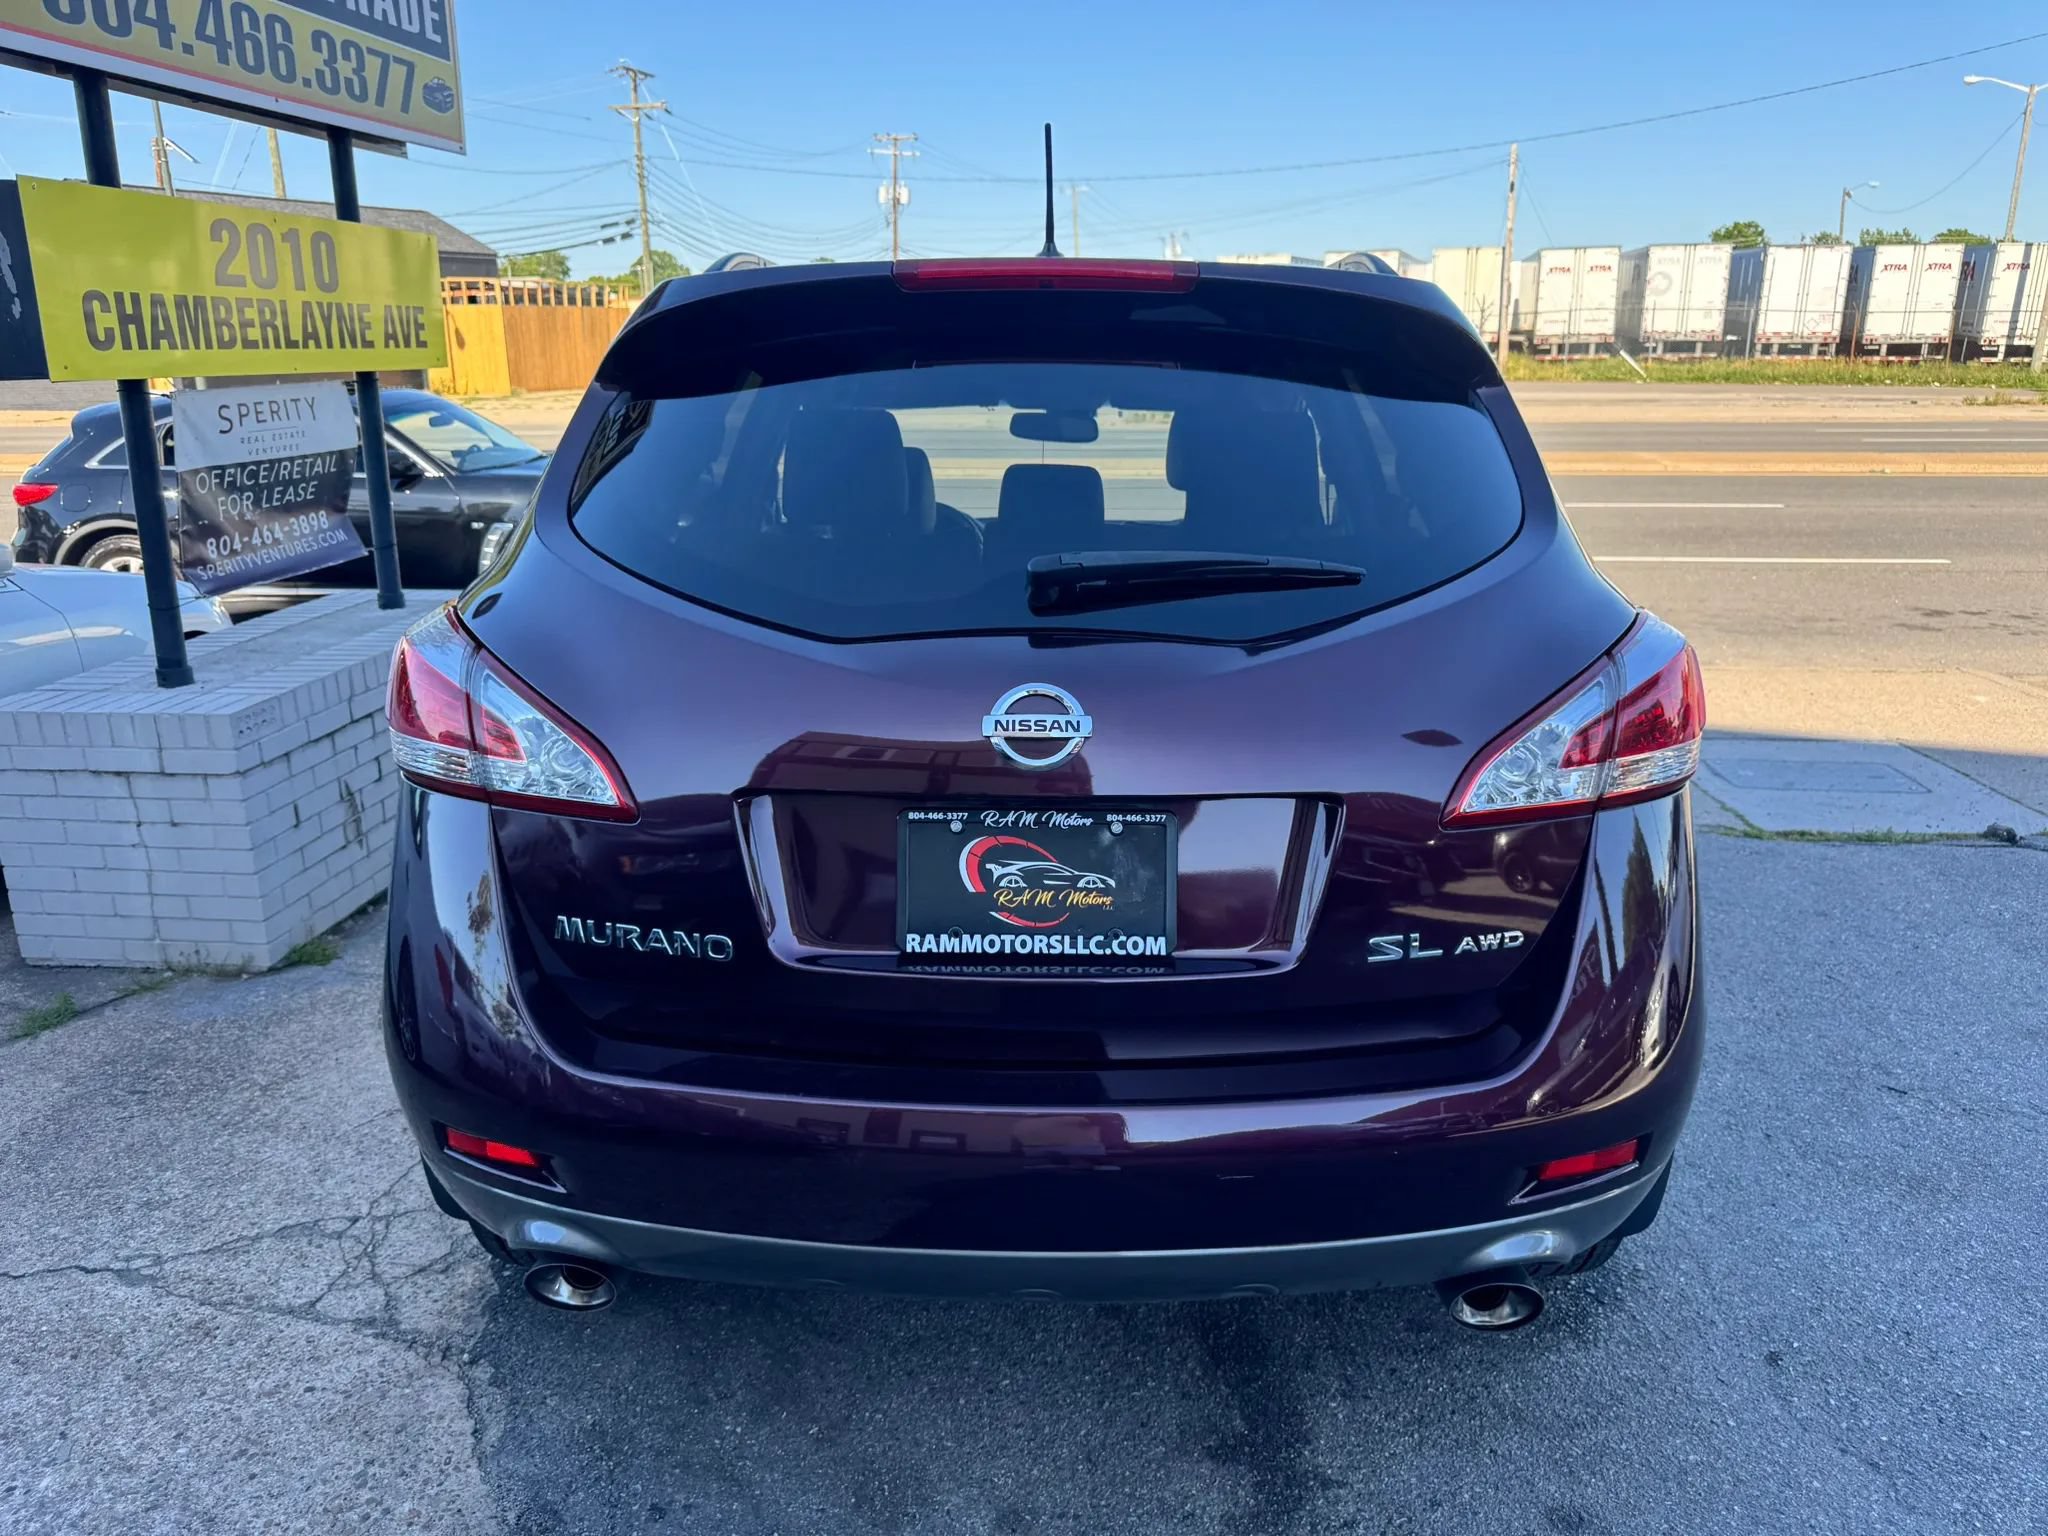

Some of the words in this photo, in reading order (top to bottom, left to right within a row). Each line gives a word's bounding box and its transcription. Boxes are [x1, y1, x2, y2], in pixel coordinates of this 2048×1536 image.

[43, 0, 416, 115] 4.466.3377
[209, 218, 340, 294] 2010
[1881, 262, 1908, 273] XTRA
[1925, 262, 1952, 272] XTRA
[2002, 262, 2031, 272] XTRA
[81, 289, 375, 352] CHAMBERLAYNE
[383, 305, 428, 349] AVE
[217, 396, 317, 434] SPERITY
[240, 434, 265, 444] REAL
[195, 454, 337, 494] OFFICE/RETAIL
[217, 491, 254, 521] FOR
[261, 480, 319, 508] LEASE
[206, 510, 329, 559] 804-464-3898
[196, 529, 348, 581] SPERITYVENTURES.COM
[994, 719, 1081, 733] NISSAN
[908, 812, 968, 820] 804-466-3377
[980, 809, 1039, 829] RAM
[1041, 810, 1094, 829] Motors
[1106, 814, 1167, 822] 804-466-3377
[993, 888, 1056, 908] RAM
[1058, 888, 1114, 908] Motors
[554, 915, 734, 962] MURANO
[906, 933, 1166, 956] RAMMOTORSLLC.COM
[1367, 933, 1443, 963] SL
[1454, 930, 1525, 955] AWD
